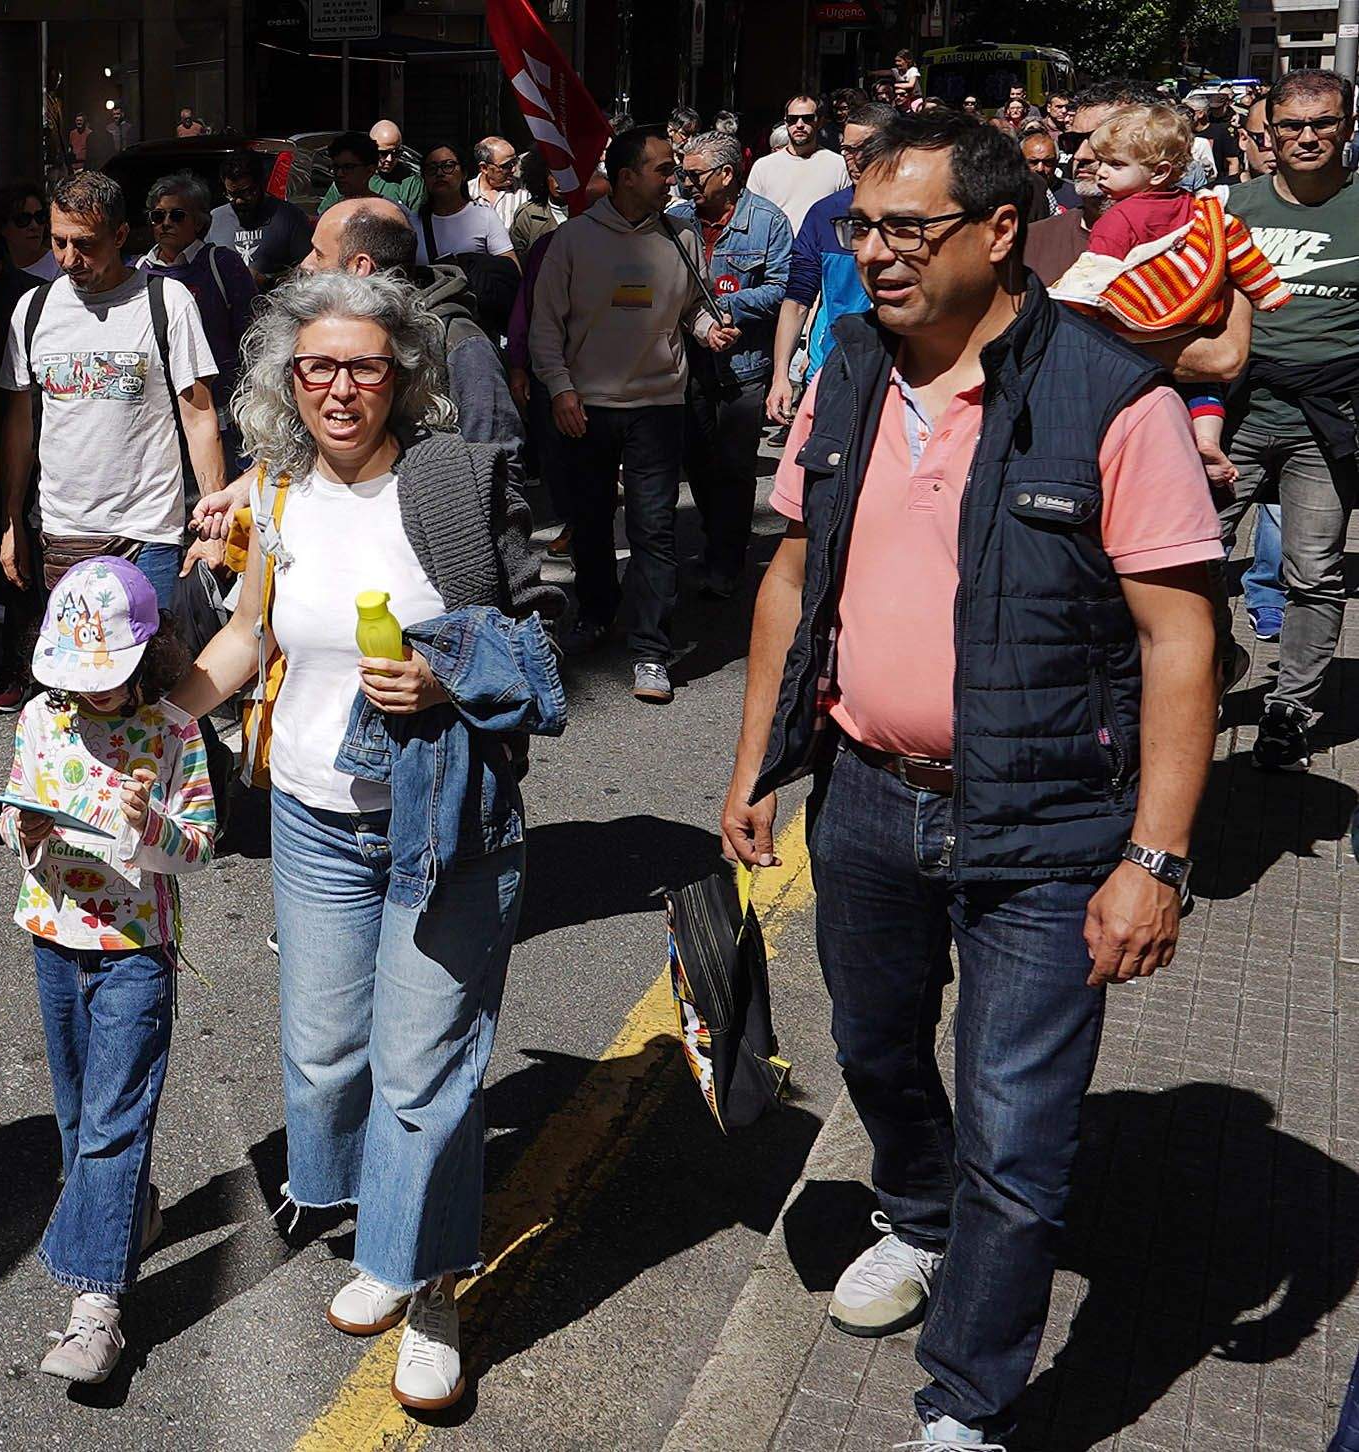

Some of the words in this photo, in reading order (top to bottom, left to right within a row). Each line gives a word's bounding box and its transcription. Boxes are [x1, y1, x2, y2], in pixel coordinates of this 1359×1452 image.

[1250, 227, 1332, 265] NIKE
[1316, 285, 1339, 298] DO
[47, 837, 107, 863] Holiday
